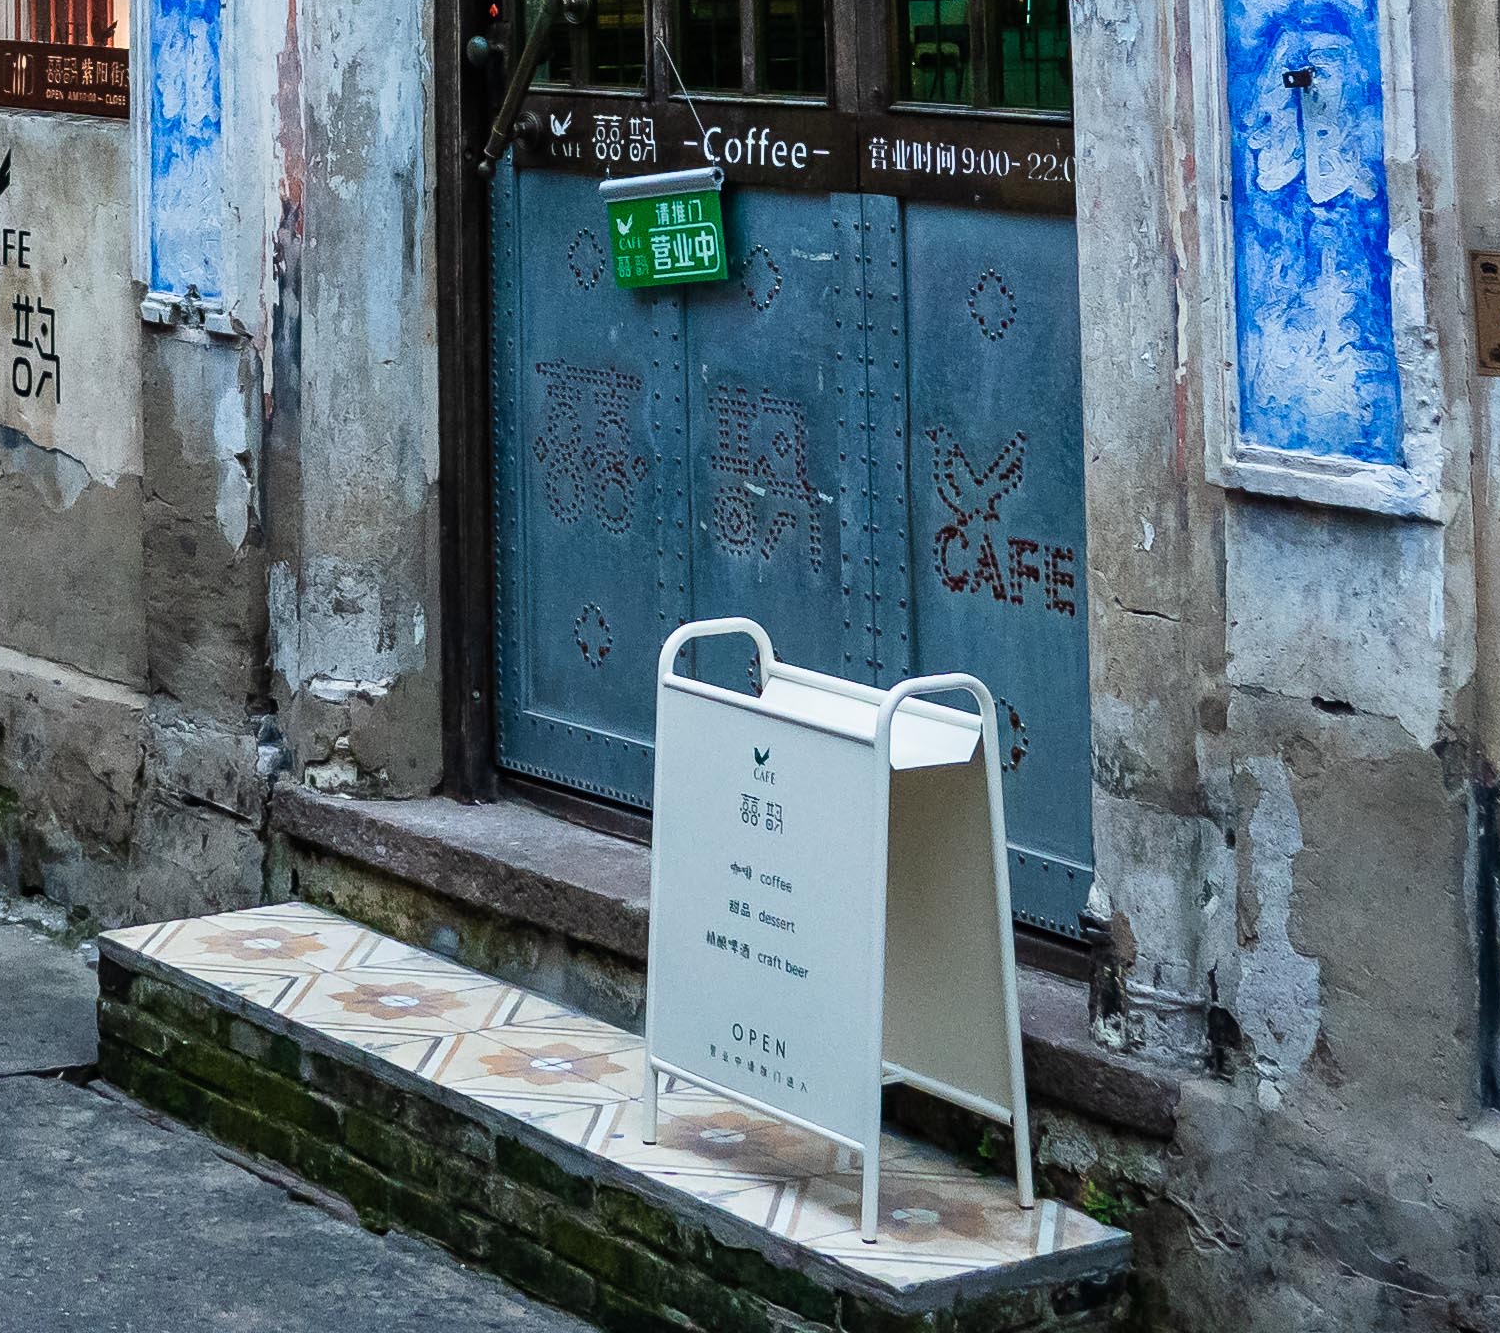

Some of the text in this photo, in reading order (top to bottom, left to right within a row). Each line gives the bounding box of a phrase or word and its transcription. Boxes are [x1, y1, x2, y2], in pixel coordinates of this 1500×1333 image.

[45, 88, 64, 100] OPEN
[551, 142, 581, 158] CAFE
[868, 136, 957, 176] 营业时间
[655, 199, 704, 226] 请推门
[618, 237, 642, 251] CAFE
[650, 230, 716, 270] 营业中
[934, 524, 1076, 617] CAFE
[753, 766, 776, 786] CAFE
[729, 860, 793, 894] 咖啡 coffee
[728, 899, 796, 934] 甜品 dessert
[757, 951, 782, 971] craft
[785, 958, 809, 980] beer
[731, 1022, 787, 1059] OPEN
